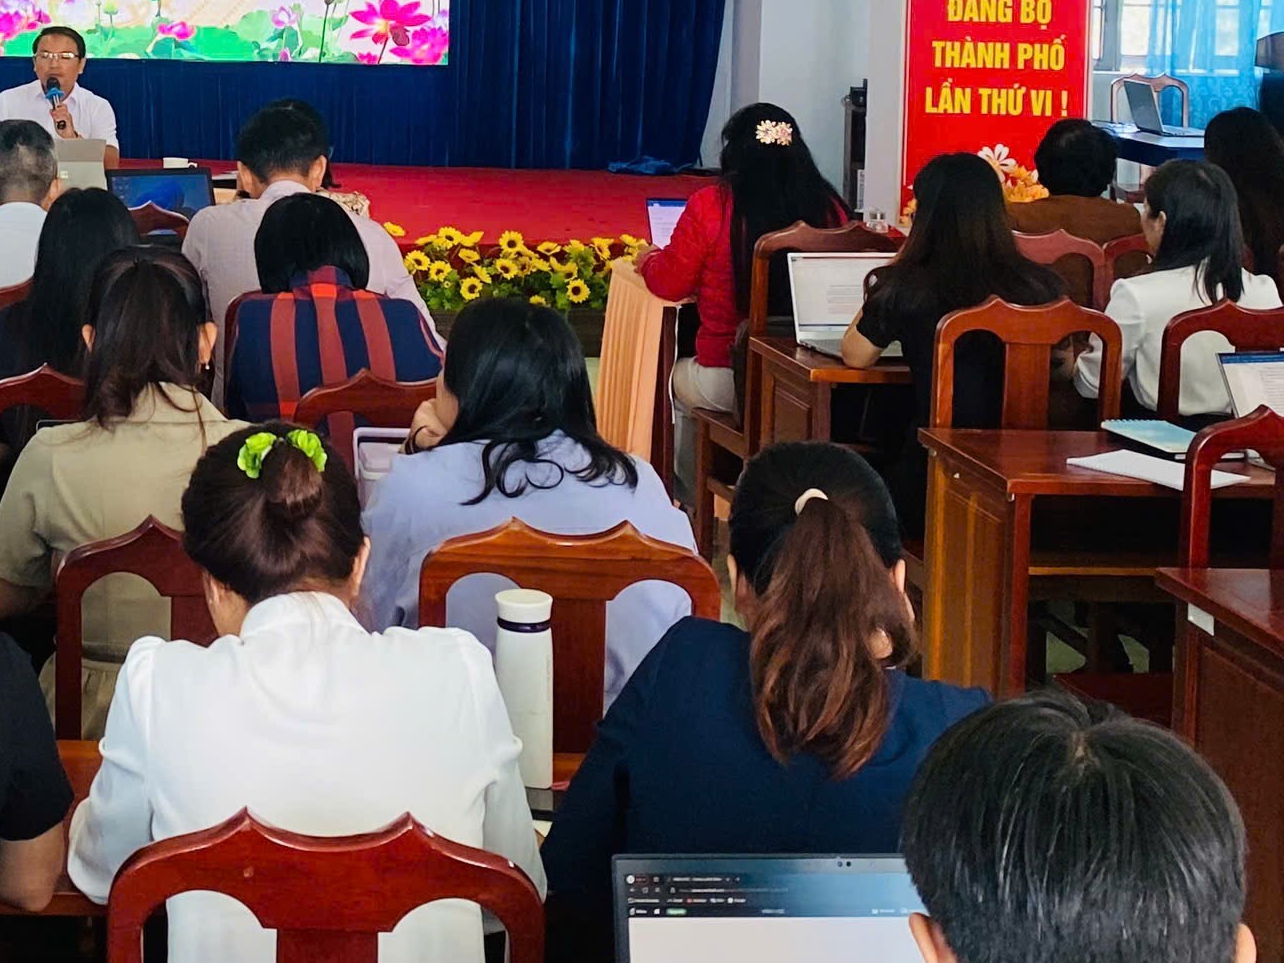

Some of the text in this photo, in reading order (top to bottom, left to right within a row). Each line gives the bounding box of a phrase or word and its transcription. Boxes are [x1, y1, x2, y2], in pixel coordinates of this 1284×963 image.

[932, 34, 1066, 71] THÀNH PHỐ
[924, 78, 971, 114] LẦN
[979, 83, 1026, 116] THỨ
[1030, 90, 1052, 116] VI
